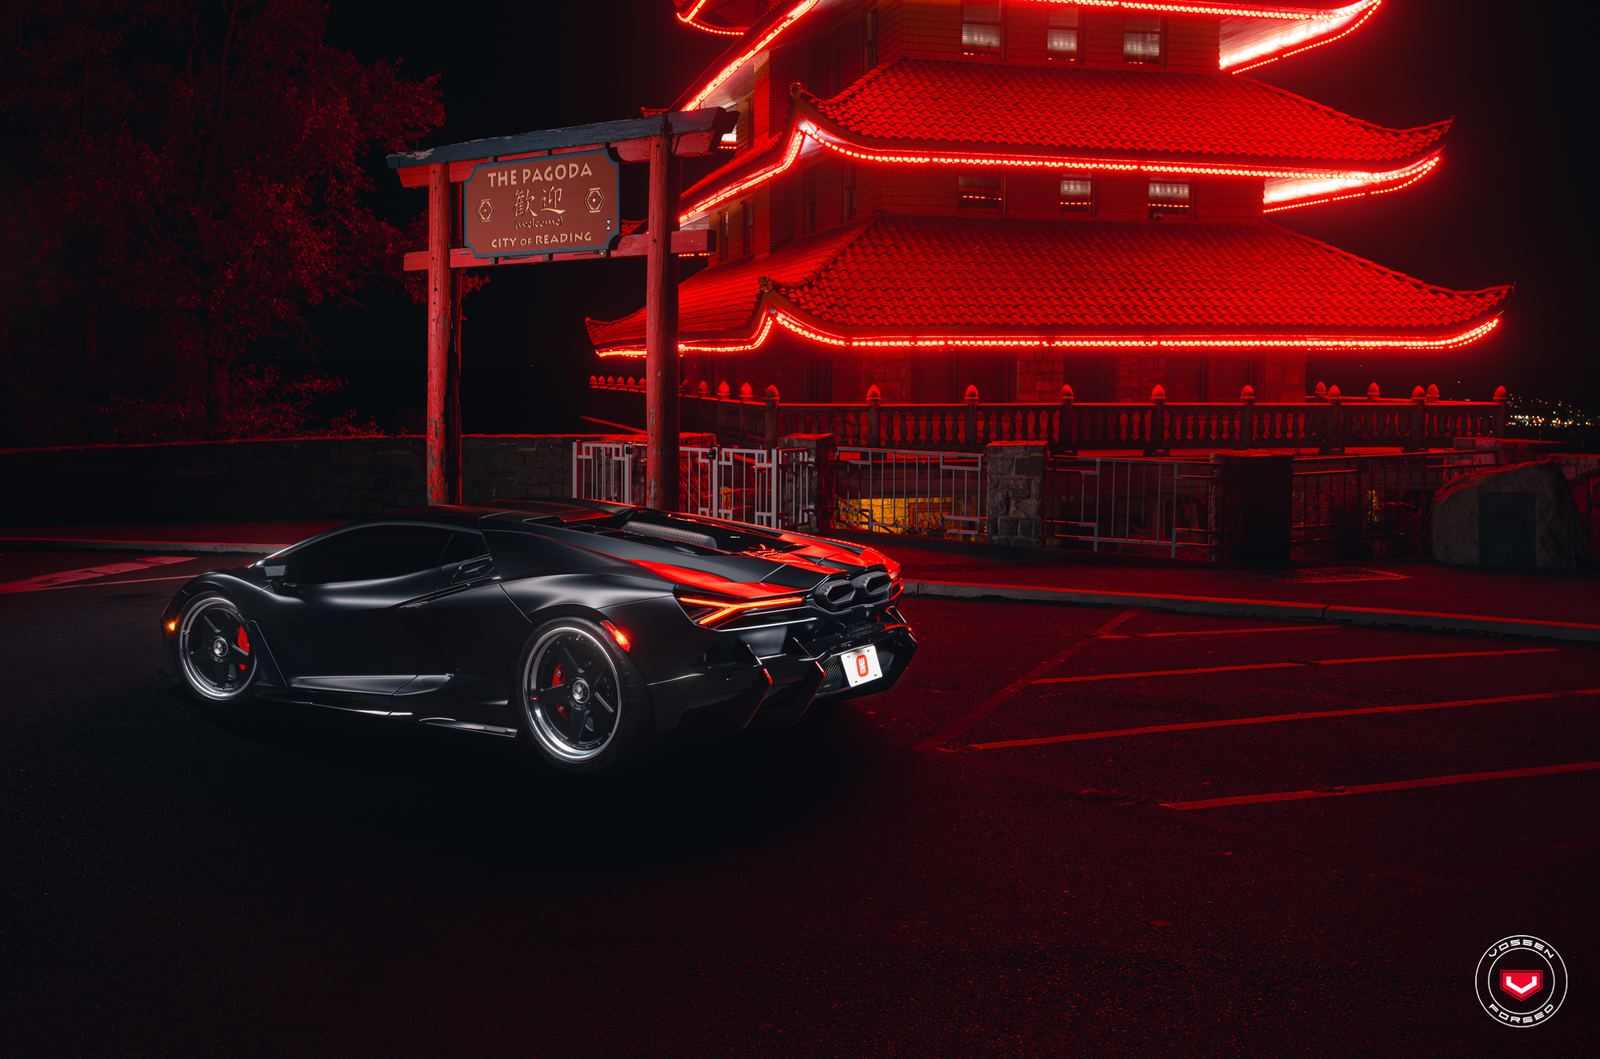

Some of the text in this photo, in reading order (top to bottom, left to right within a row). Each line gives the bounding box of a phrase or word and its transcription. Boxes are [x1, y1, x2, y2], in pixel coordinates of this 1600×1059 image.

[488, 163, 592, 187] THE PAGODA
[515, 186, 565, 217] 歡迎
[491, 237, 517, 248] CITY
[535, 232, 592, 245] READING
